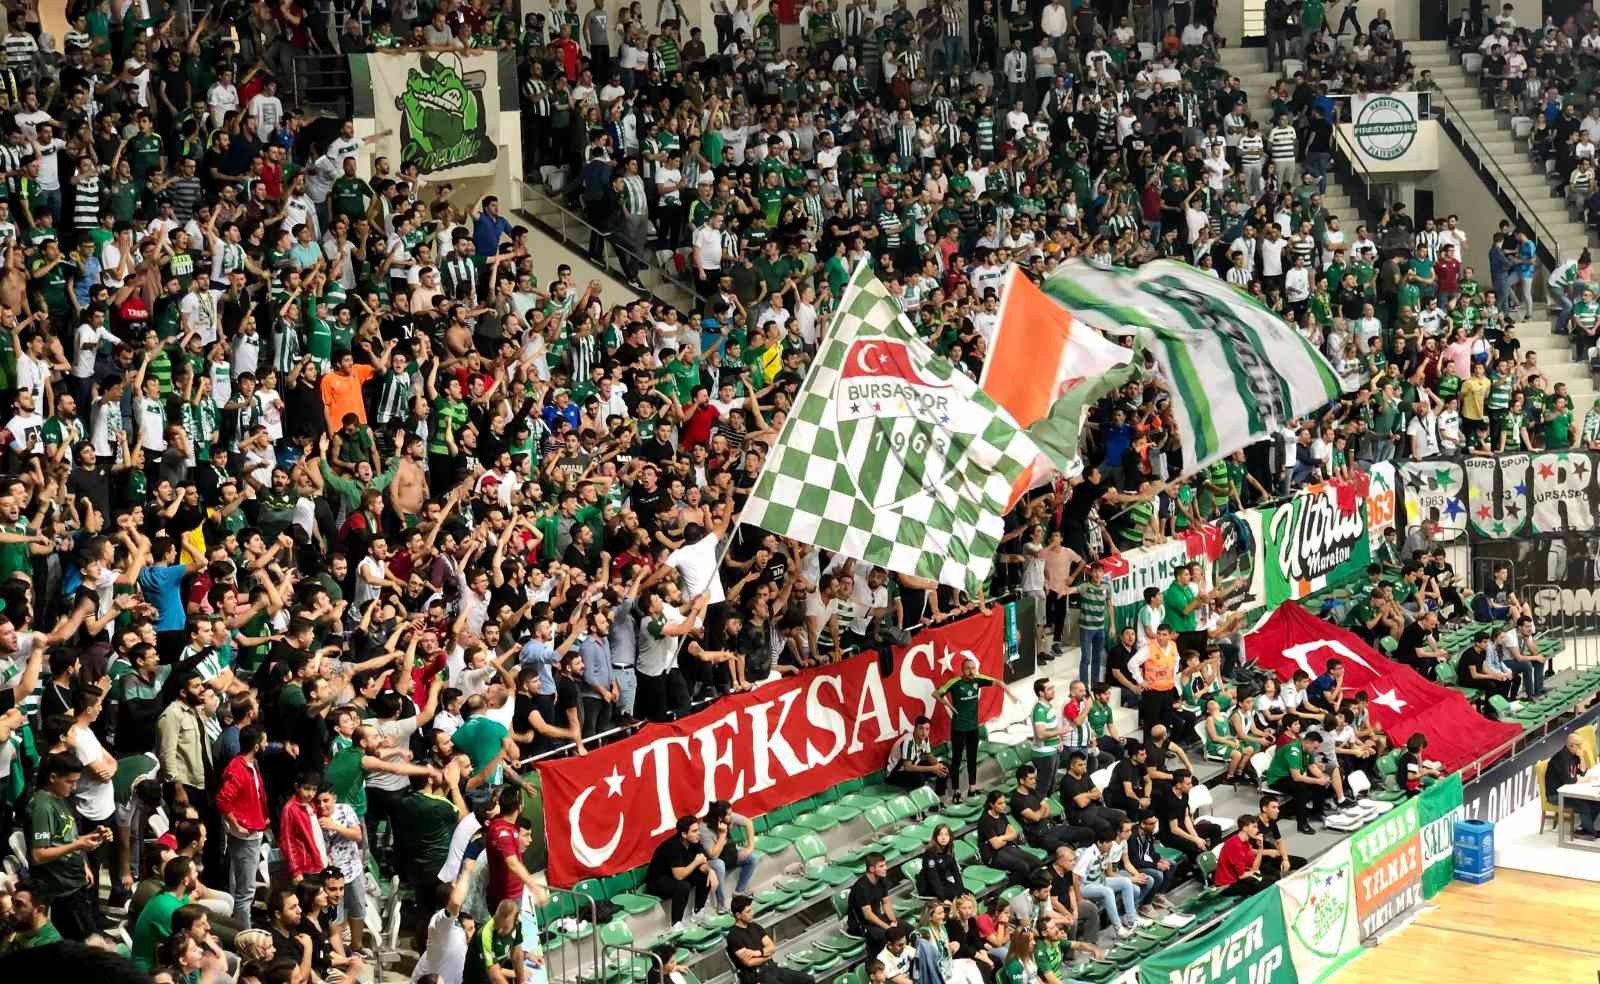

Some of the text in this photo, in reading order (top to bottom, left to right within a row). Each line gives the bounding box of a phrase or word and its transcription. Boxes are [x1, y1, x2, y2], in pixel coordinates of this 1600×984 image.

[848, 383, 949, 412] BURSASPOR
[875, 431, 946, 456] 1963
[1420, 496, 1444, 506] 1963
[632, 640, 939, 837] TEKSAS
[1362, 845, 1417, 902] YILMAZ
